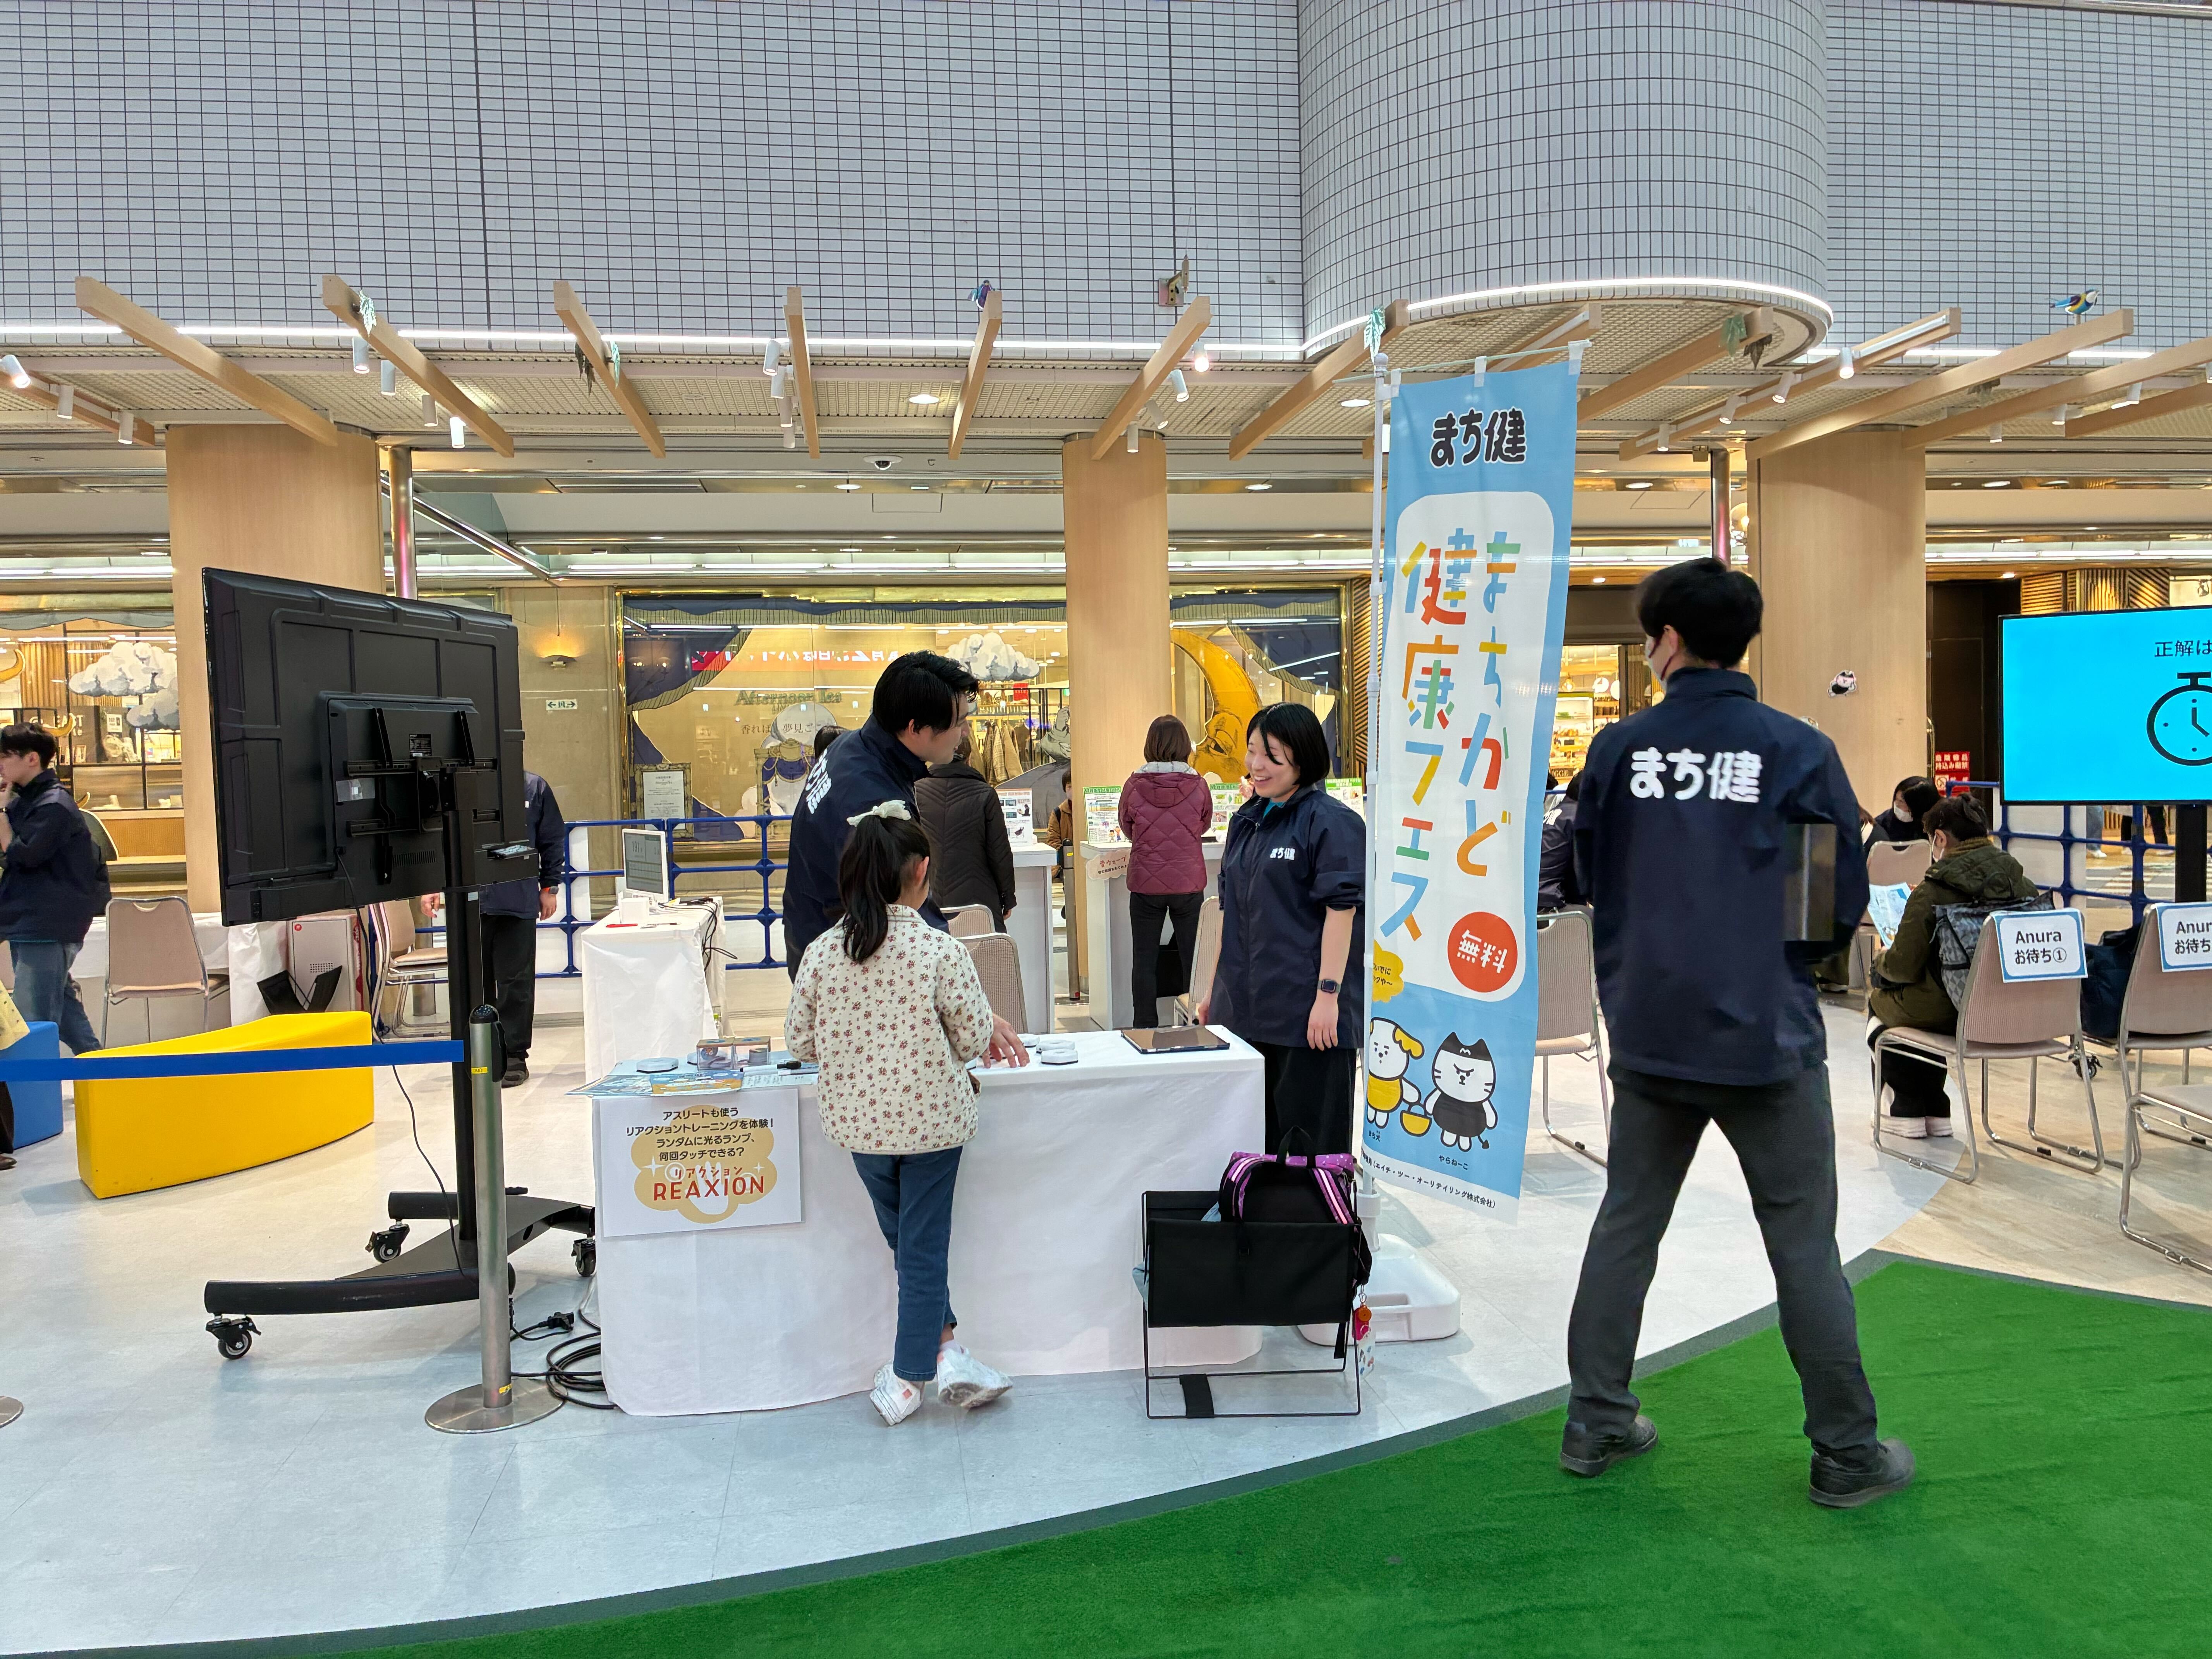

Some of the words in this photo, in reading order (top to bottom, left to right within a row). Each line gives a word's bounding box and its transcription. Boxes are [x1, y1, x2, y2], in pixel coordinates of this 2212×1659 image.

[1429, 406, 1528, 469] まち健
[1457, 531, 1521, 876] まちかど
[1380, 527, 1477, 941] 健康フェス
[1630, 746, 1762, 803] まち健
[2176, 921, 2212, 934] Anur
[2016, 931, 2061, 944] Anura
[1457, 929, 1508, 973] 無料
[2175, 938, 2210, 954] お待ち
[663, 1107, 739, 1121] アスリートも使う
[626, 1118, 773, 1136] リアクショントレーニングを体験！
[656, 1133, 755, 1148] ランダムに光るランプ、
[659, 1147, 744, 1162] 何回タッチできる？
[1439, 1154, 1468, 1170] やらねーこ
[675, 1166, 742, 1179] リアクション
[654, 1175, 764, 1201] REAXION
